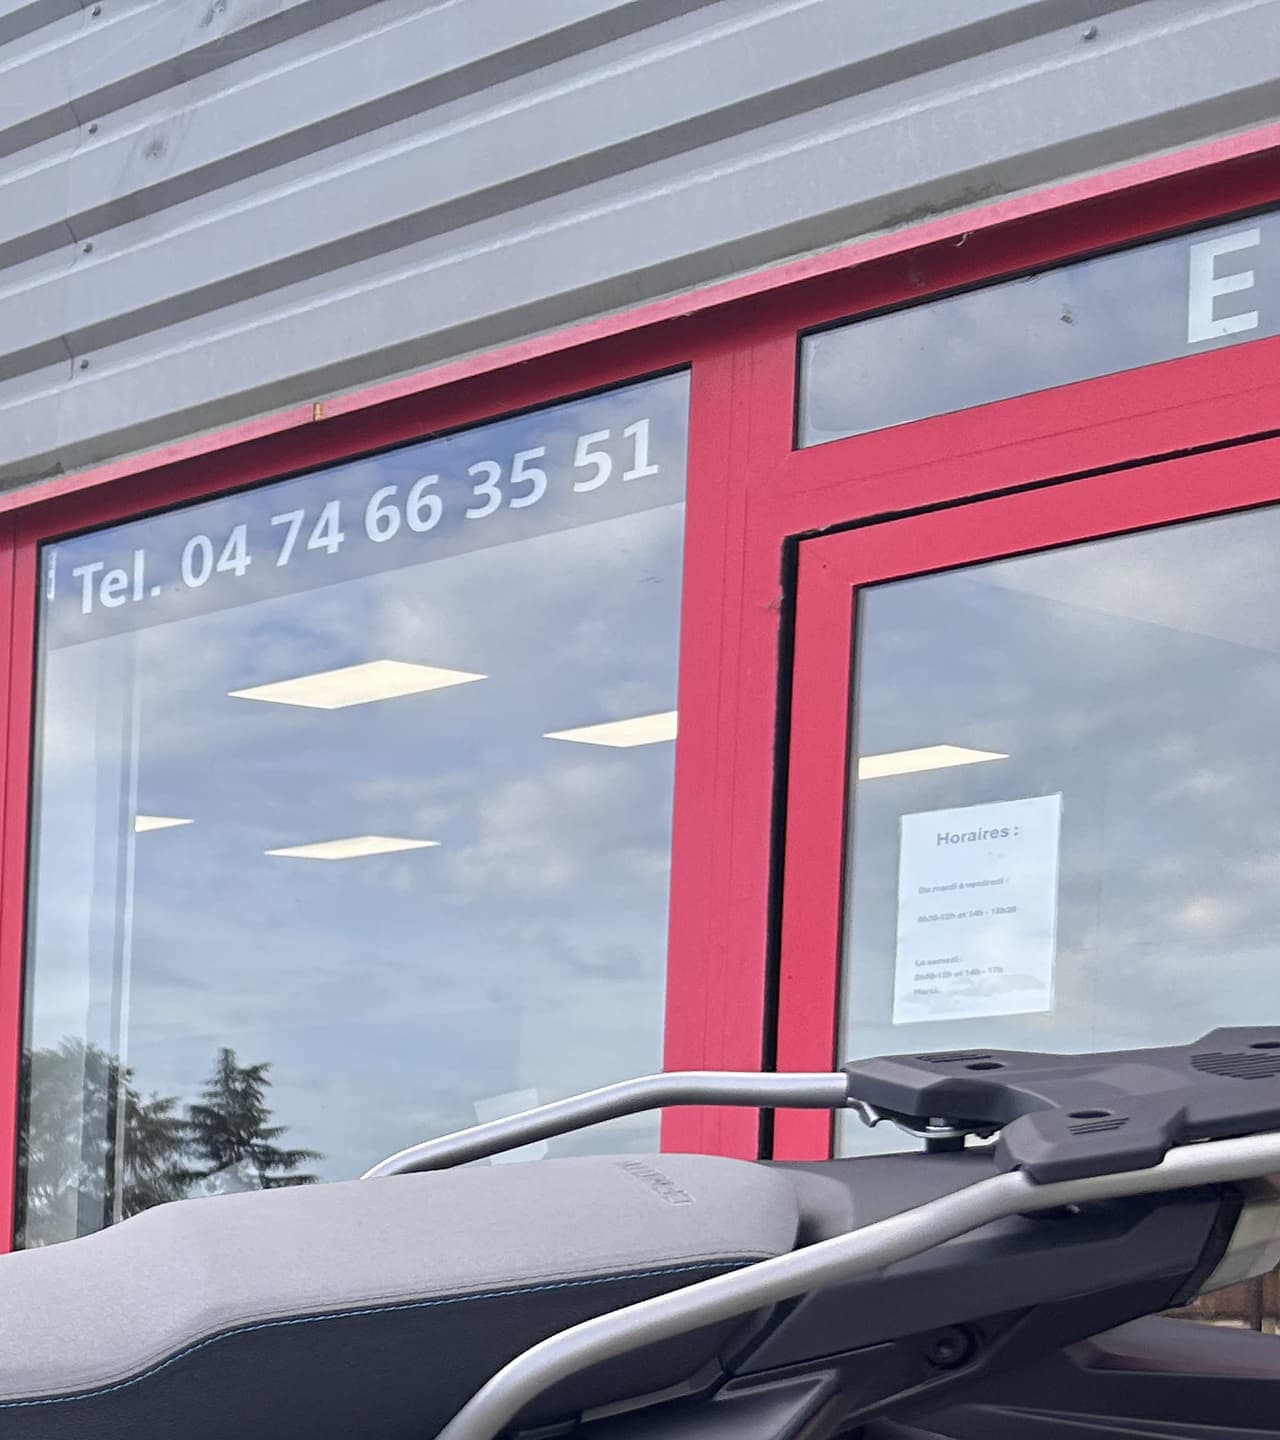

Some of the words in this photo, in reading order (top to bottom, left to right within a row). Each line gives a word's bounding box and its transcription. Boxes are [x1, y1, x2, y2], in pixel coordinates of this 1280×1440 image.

[1187, 227, 1261, 344] E
[72, 549, 161, 615] Tel.
[180, 523, 252, 588] 04
[271, 499, 344, 567] 74
[364, 473, 443, 543] 66
[465, 446, 548, 519] 35
[573, 417, 660, 493] 51
[936, 827, 1010, 847] Horaires
